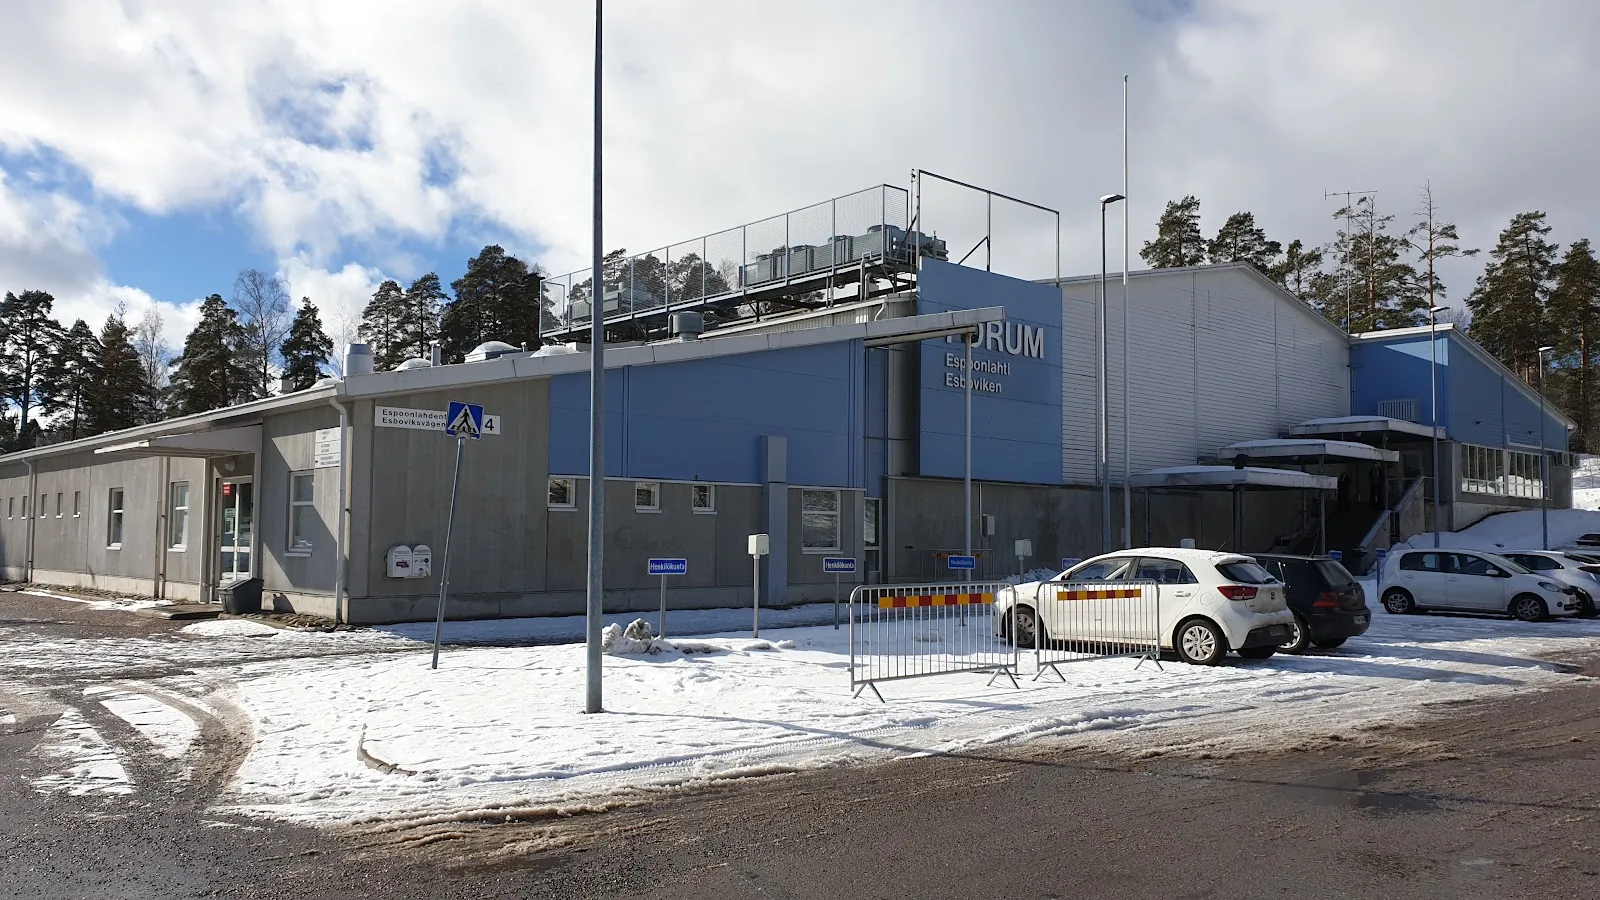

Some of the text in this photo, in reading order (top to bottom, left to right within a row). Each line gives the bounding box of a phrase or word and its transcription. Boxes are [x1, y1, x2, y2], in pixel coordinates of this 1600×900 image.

[946, 320, 1044, 359] ORUM
[382, 408, 447, 420] Espoonlahdent
[382, 416, 446, 429] Esboviksvägen
[484, 418, 495, 431] 4
[650, 563, 685, 571] Henkilökunta
